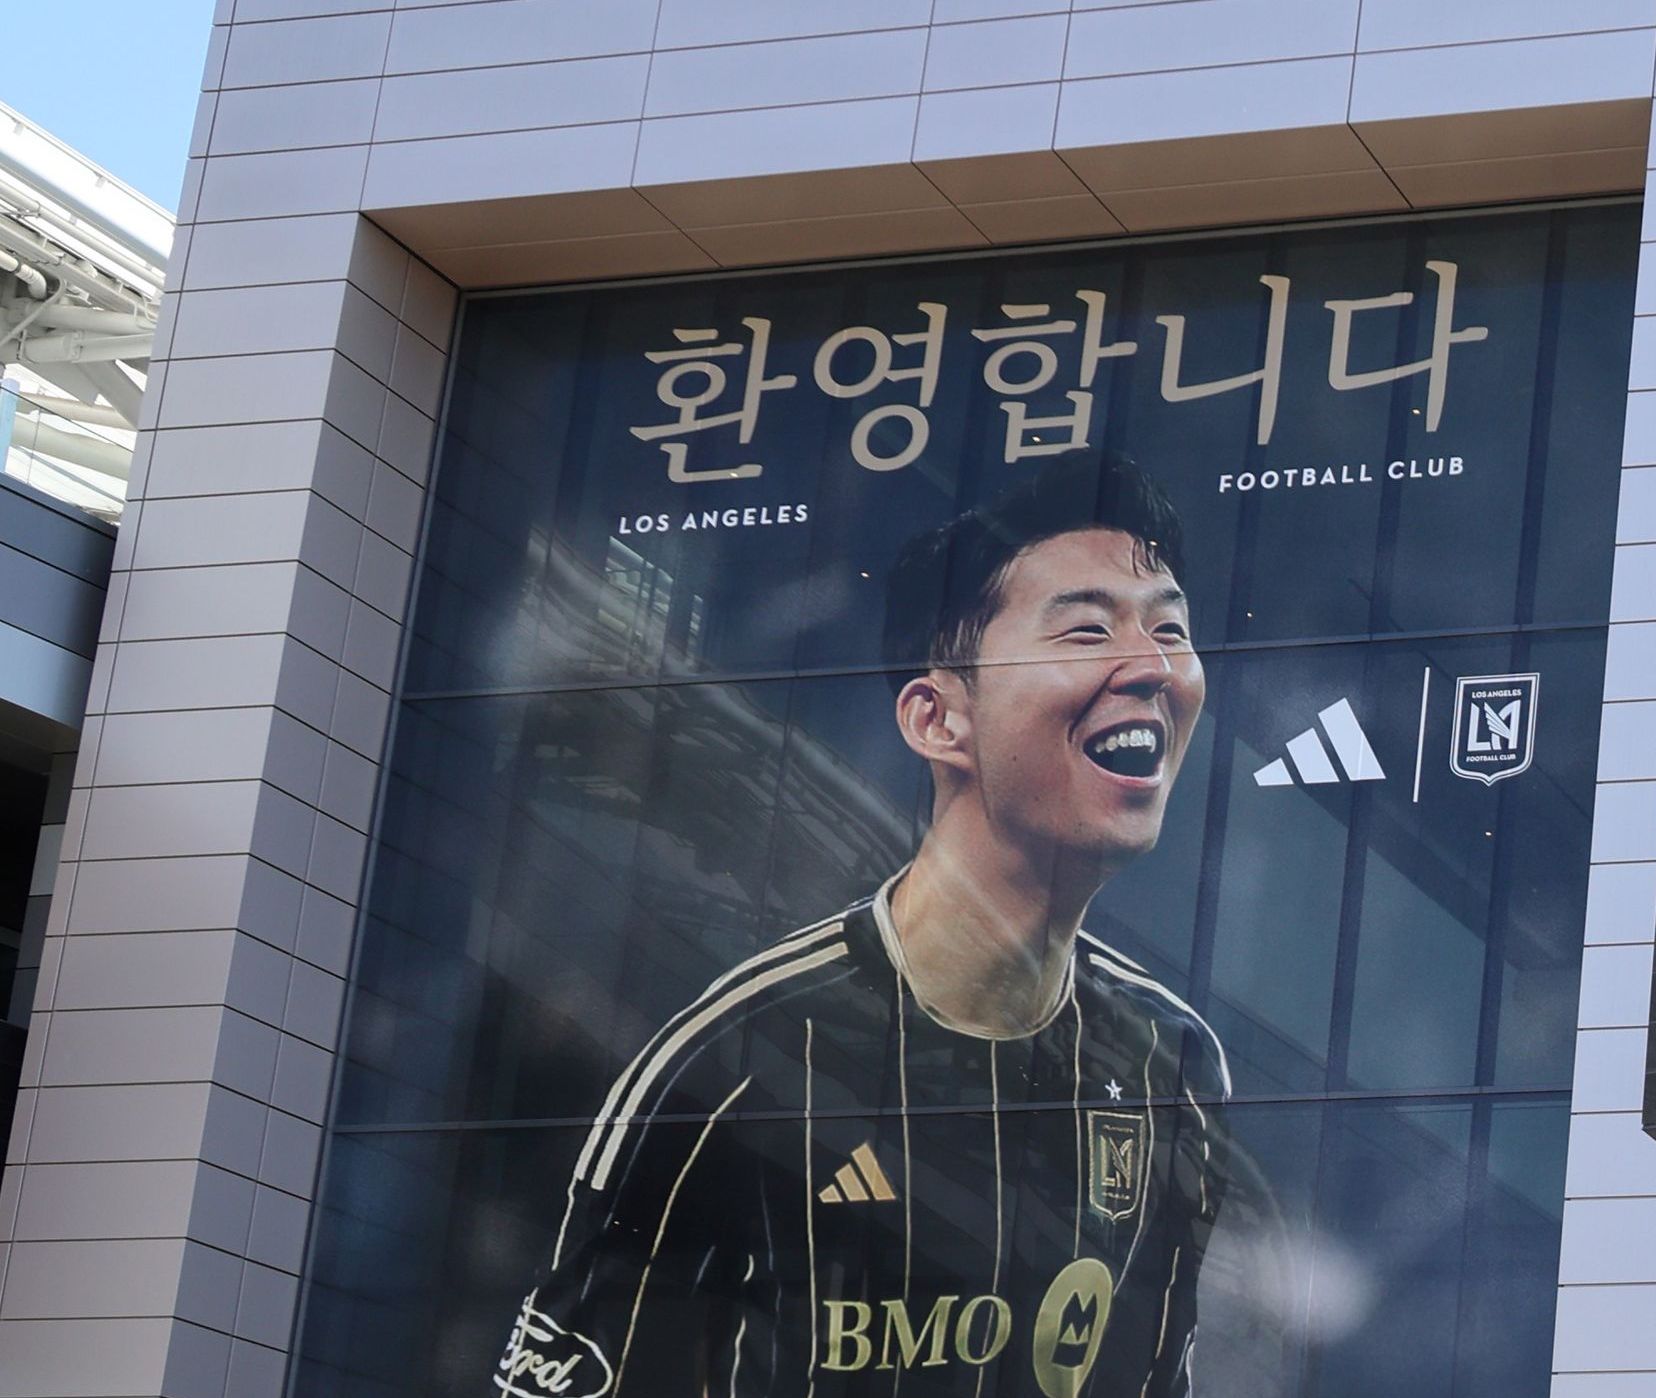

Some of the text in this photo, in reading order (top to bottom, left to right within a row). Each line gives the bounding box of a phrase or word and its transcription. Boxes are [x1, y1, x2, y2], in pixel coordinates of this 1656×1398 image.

[629, 260, 1488, 484] 환영합니다
[1218, 456, 1464, 493] FOOTBALL CLUB
[618, 503, 809, 534] LOS ANGELES
[1471, 689, 1522, 699] LOS ANGELES
[821, 1294, 1012, 1373] BMO
